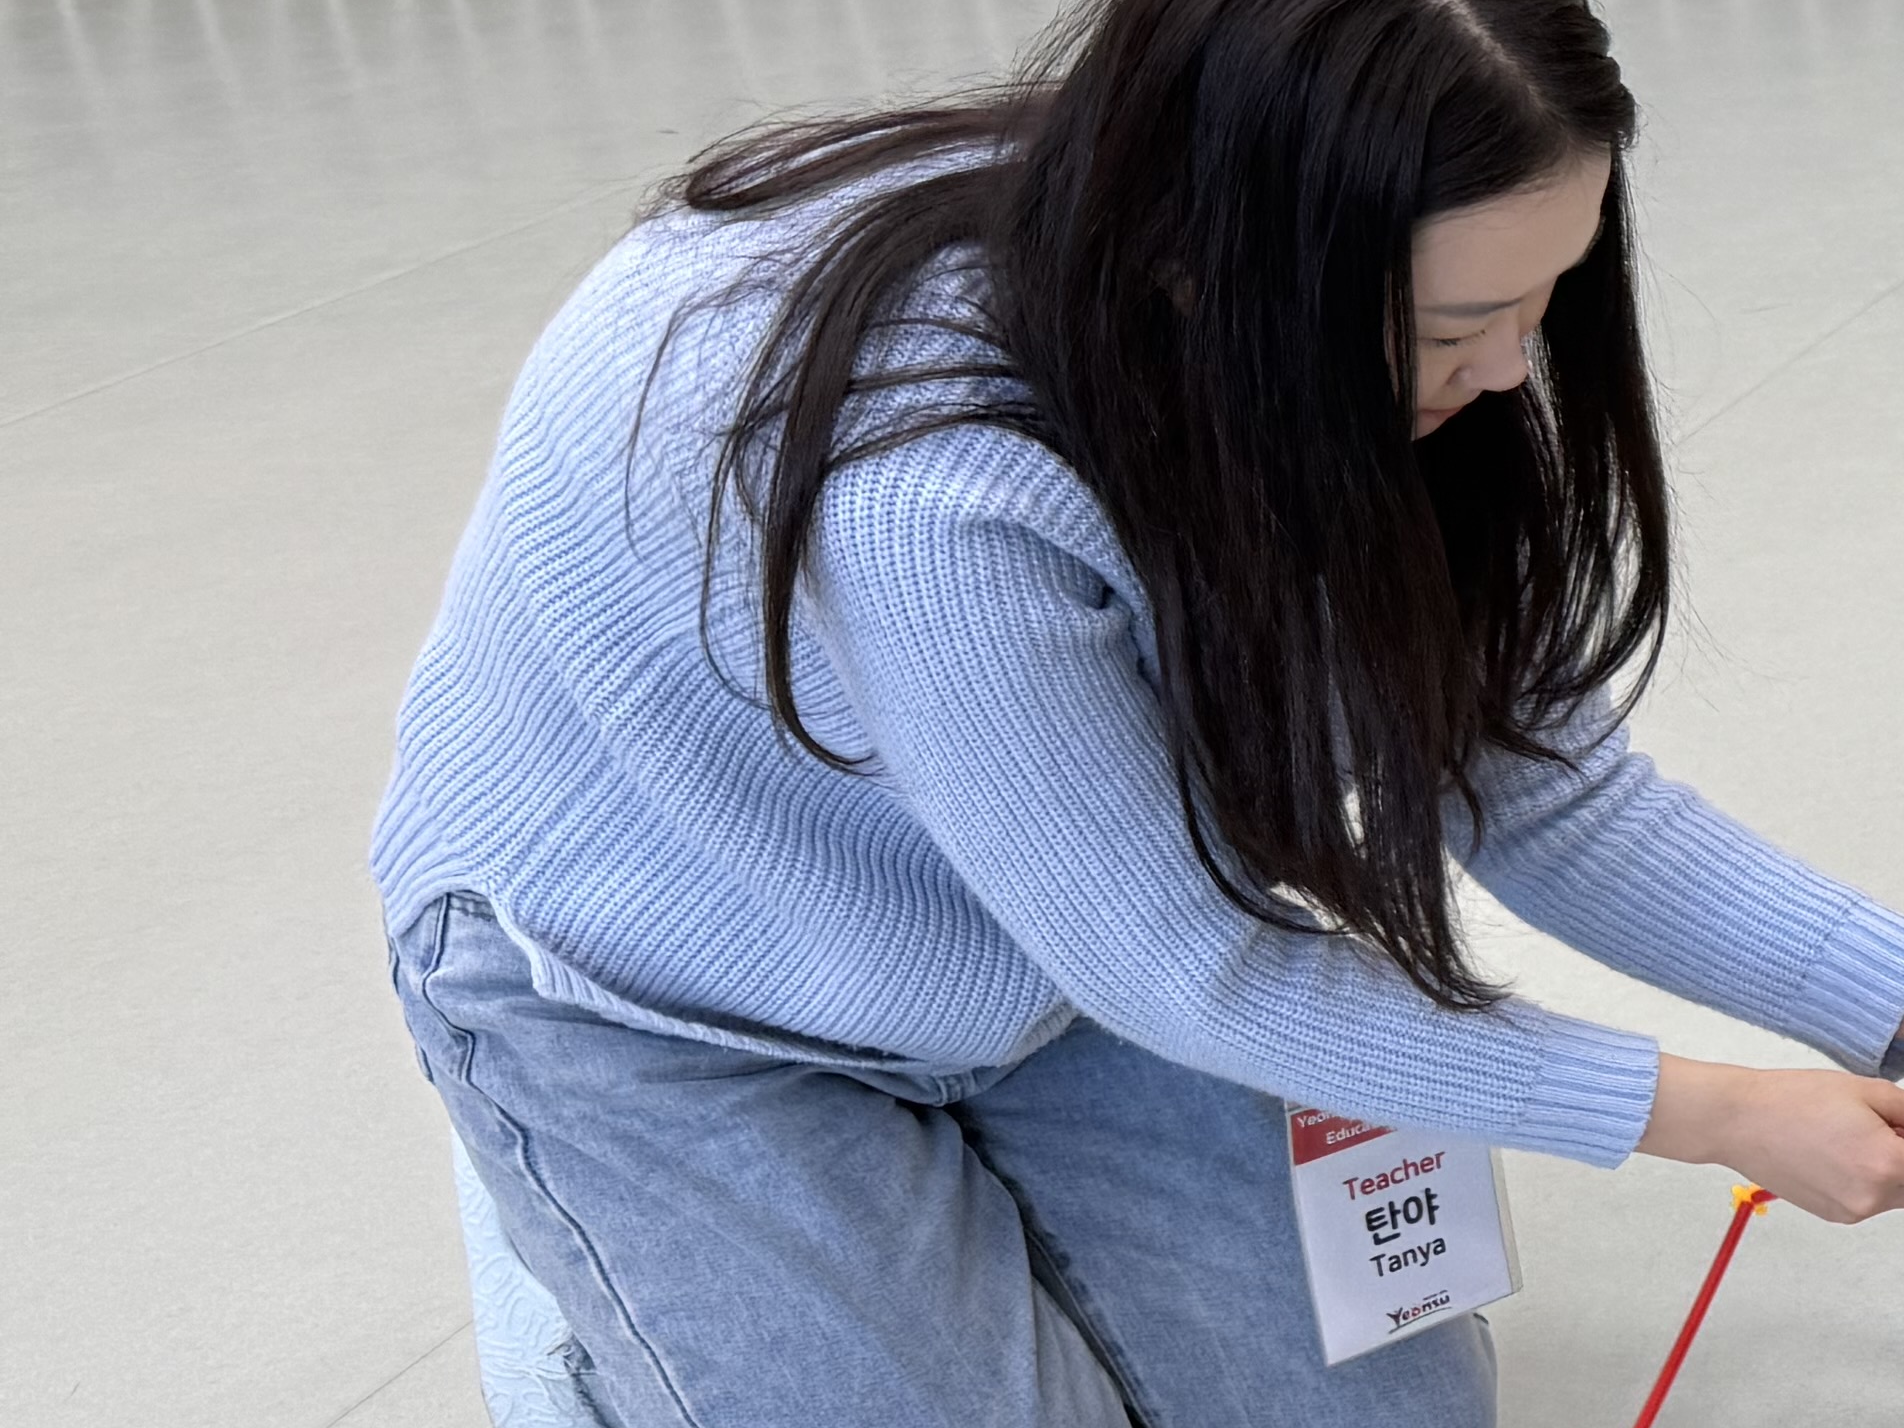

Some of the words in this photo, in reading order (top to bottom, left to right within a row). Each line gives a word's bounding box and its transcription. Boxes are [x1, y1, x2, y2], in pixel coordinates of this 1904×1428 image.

[1342, 1151, 1446, 1200] Teacher
[1365, 1187, 1440, 1246] 탄야
[1369, 1237, 1446, 1277] Tanya
